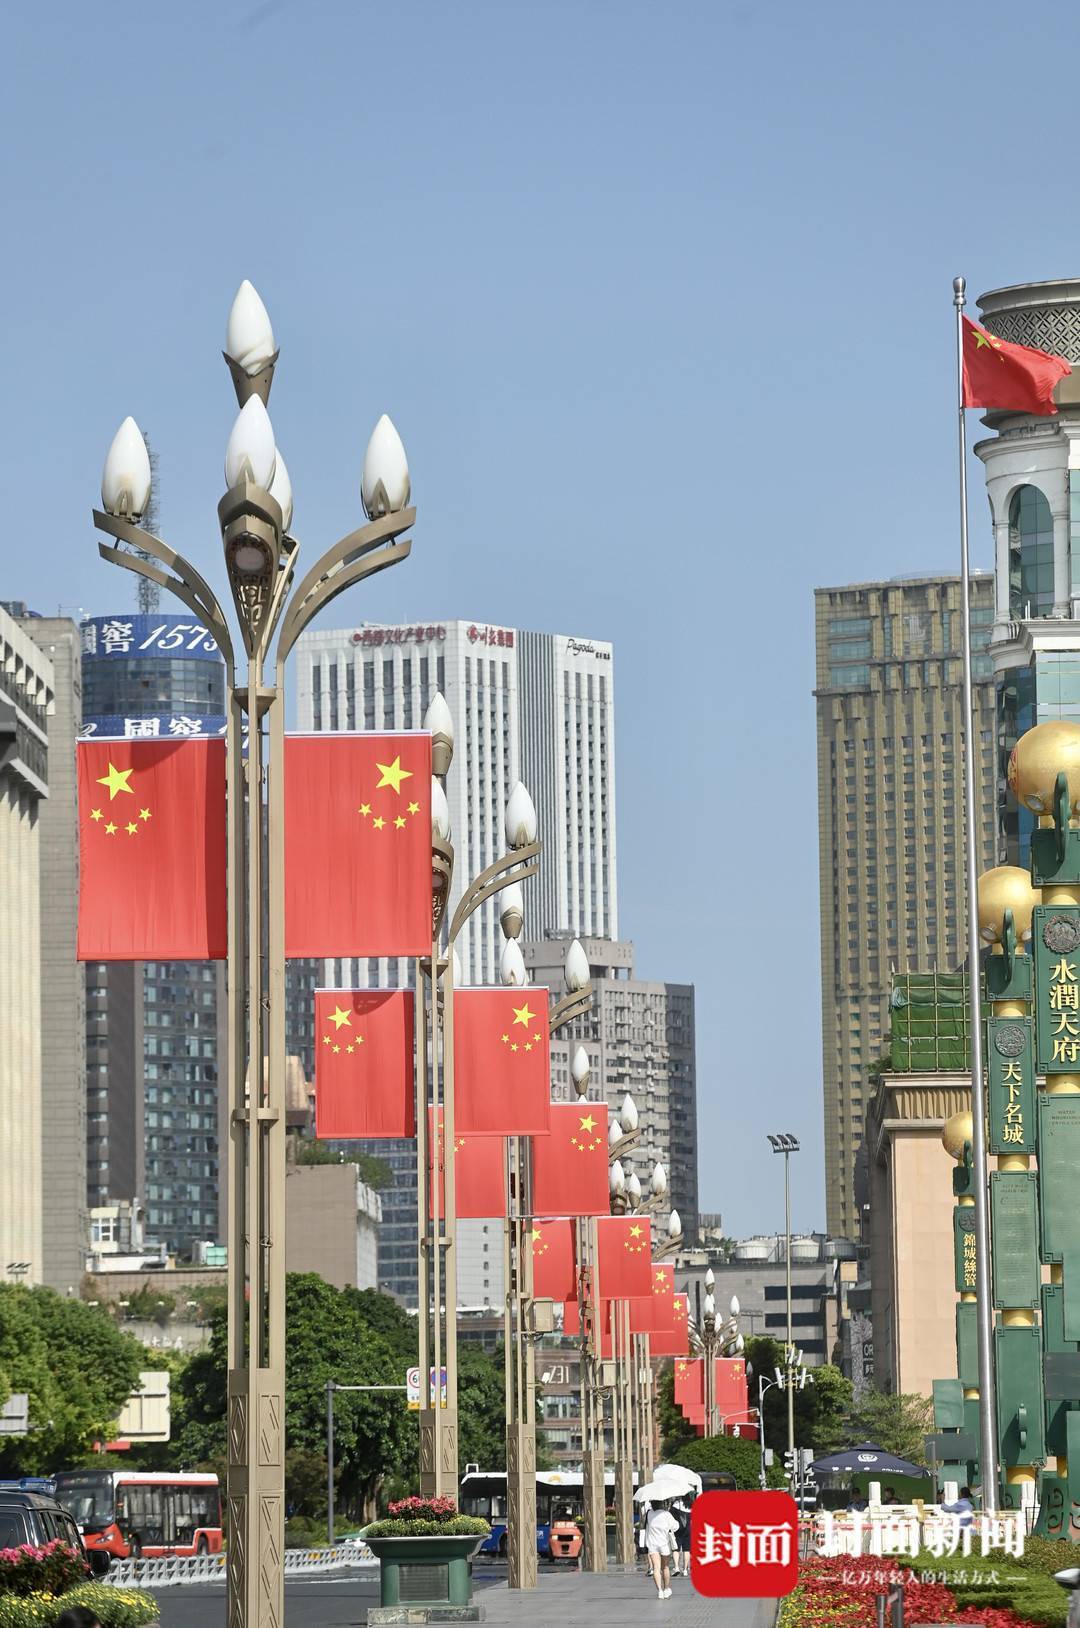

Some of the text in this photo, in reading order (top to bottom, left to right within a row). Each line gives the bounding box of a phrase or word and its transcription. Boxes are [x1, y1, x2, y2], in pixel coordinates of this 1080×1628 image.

[1049, 958, 1080, 1063] 水潤天府
[1000, 1061, 1024, 1144] 天下名城
